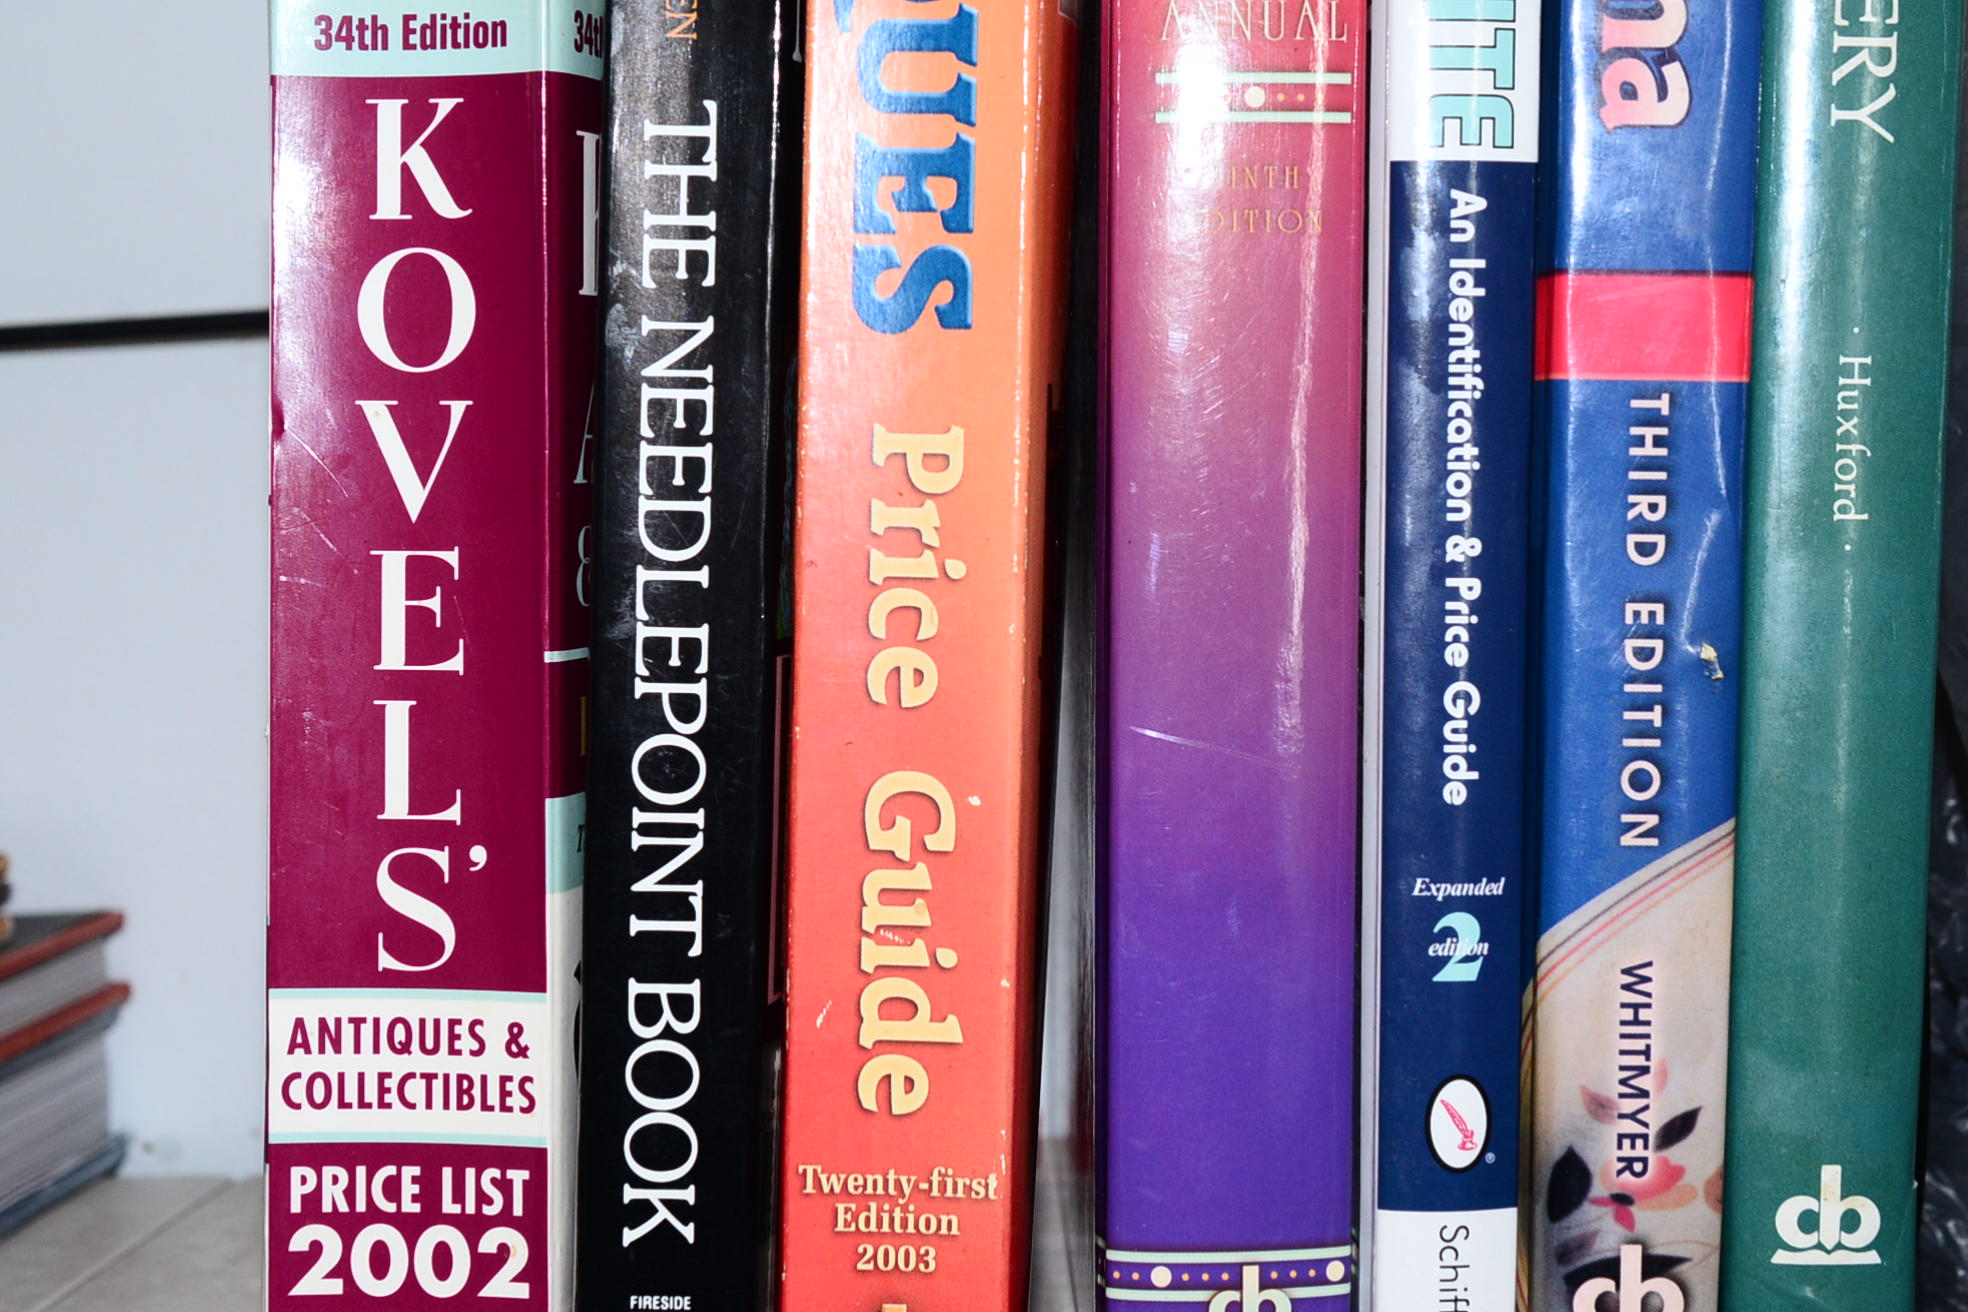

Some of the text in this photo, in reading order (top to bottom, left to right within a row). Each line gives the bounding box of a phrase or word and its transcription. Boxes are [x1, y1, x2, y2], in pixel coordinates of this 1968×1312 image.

[313, 14, 508, 51] 34th Edition
[833, 0, 978, 335] UES
[1833, 354, 1873, 522] Huxford
[1443, 188, 1488, 806] An Identification & Price Guide
[354, 97, 488, 973] KOVELS'
[1620, 393, 1670, 847] THIRD EDITION
[623, 99, 718, 1248] THE NEEDLEPOINT BOOK
[857, 423, 967, 1116] Price Guide
[1412, 877, 1505, 902] Expanded
[1428, 937, 1489, 957] edition
[1432, 911, 1484, 982] 2
[287, 1016, 530, 1059] ANTIQUES &
[281, 1071, 536, 1114] COLLECTIBLES
[1616, 960, 1654, 1179] WHITMYER
[290, 1166, 530, 1217] PRICE LIST
[798, 1164, 999, 1205] Twenty-first
[834, 1203, 961, 1236] Edition
[288, 1223, 530, 1300] 2002
[856, 1244, 937, 1274] 2003
[630, 1295, 692, 1310] FIRESIDE
